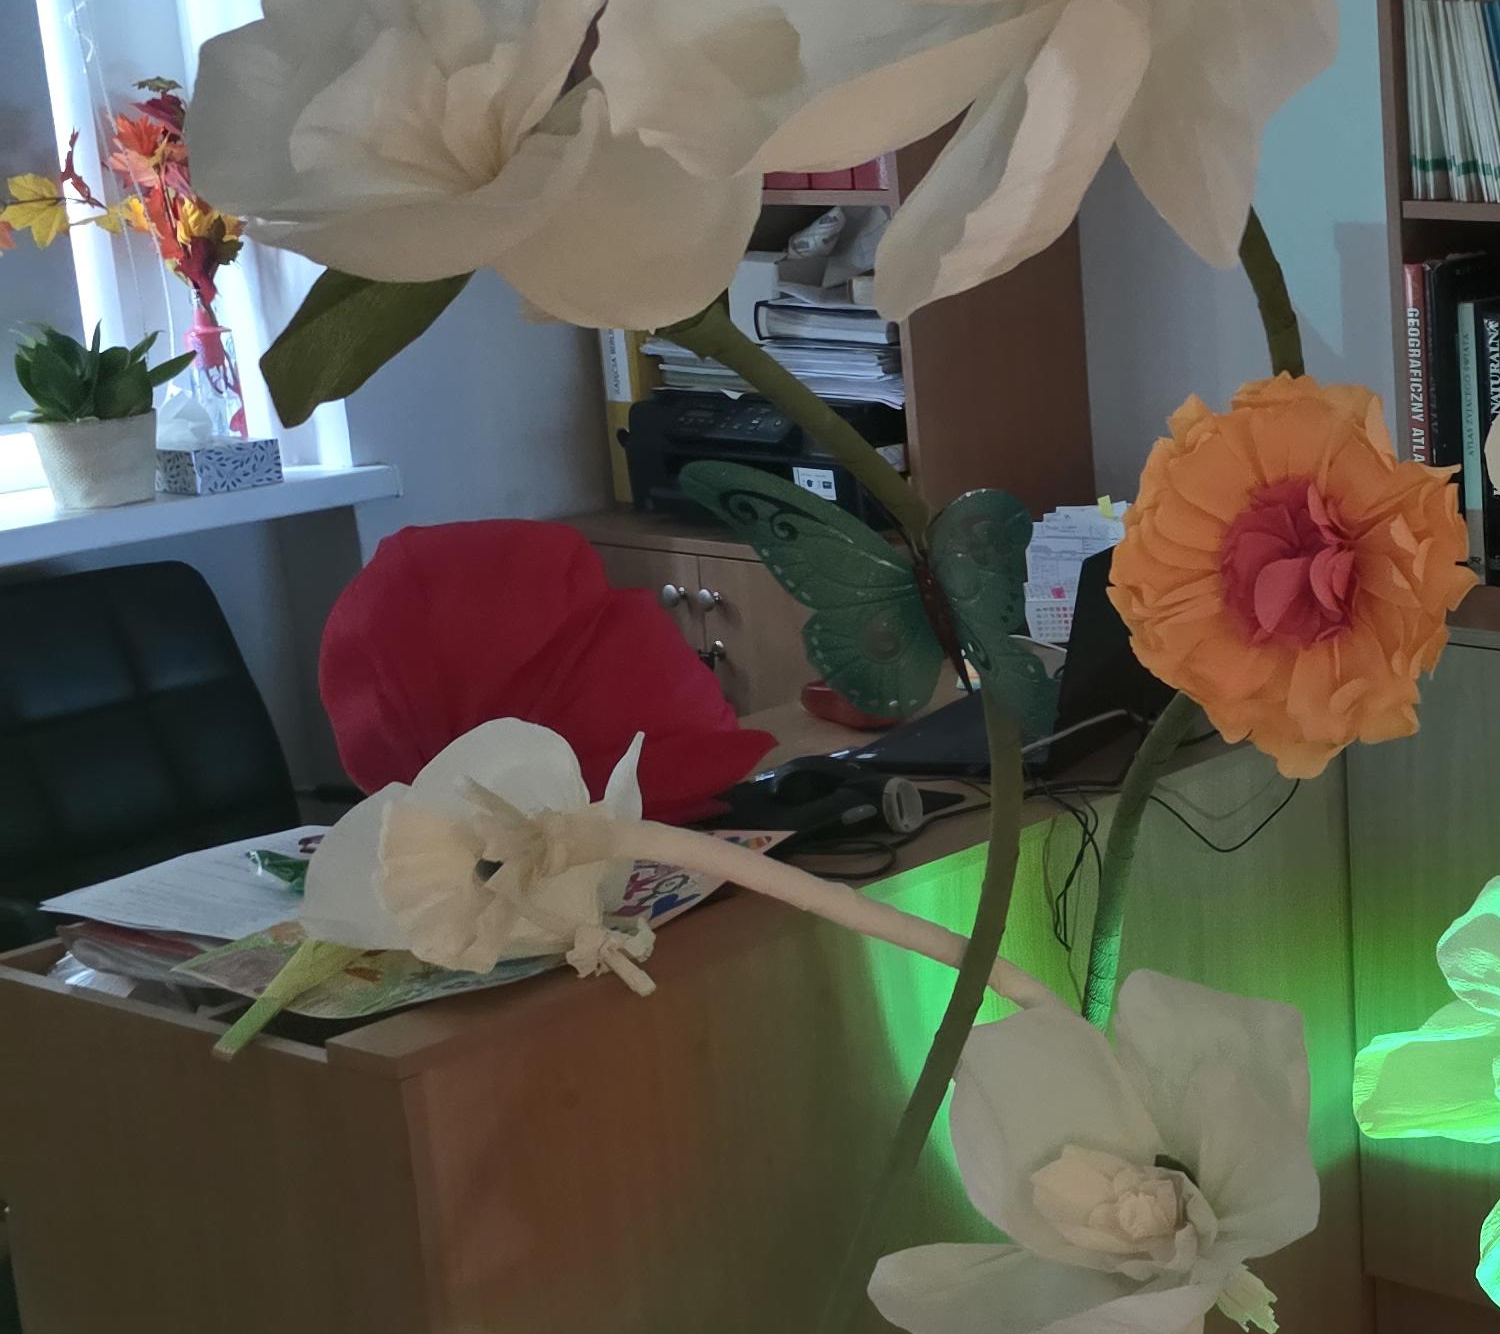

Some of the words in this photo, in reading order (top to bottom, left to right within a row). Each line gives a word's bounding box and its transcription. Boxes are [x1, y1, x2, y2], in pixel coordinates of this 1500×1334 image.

[1407, 308, 1424, 423] GEOGRAFICZNY
[1484, 318, 1500, 415] NATURALNA
[1412, 427, 1426, 464] ATLA
